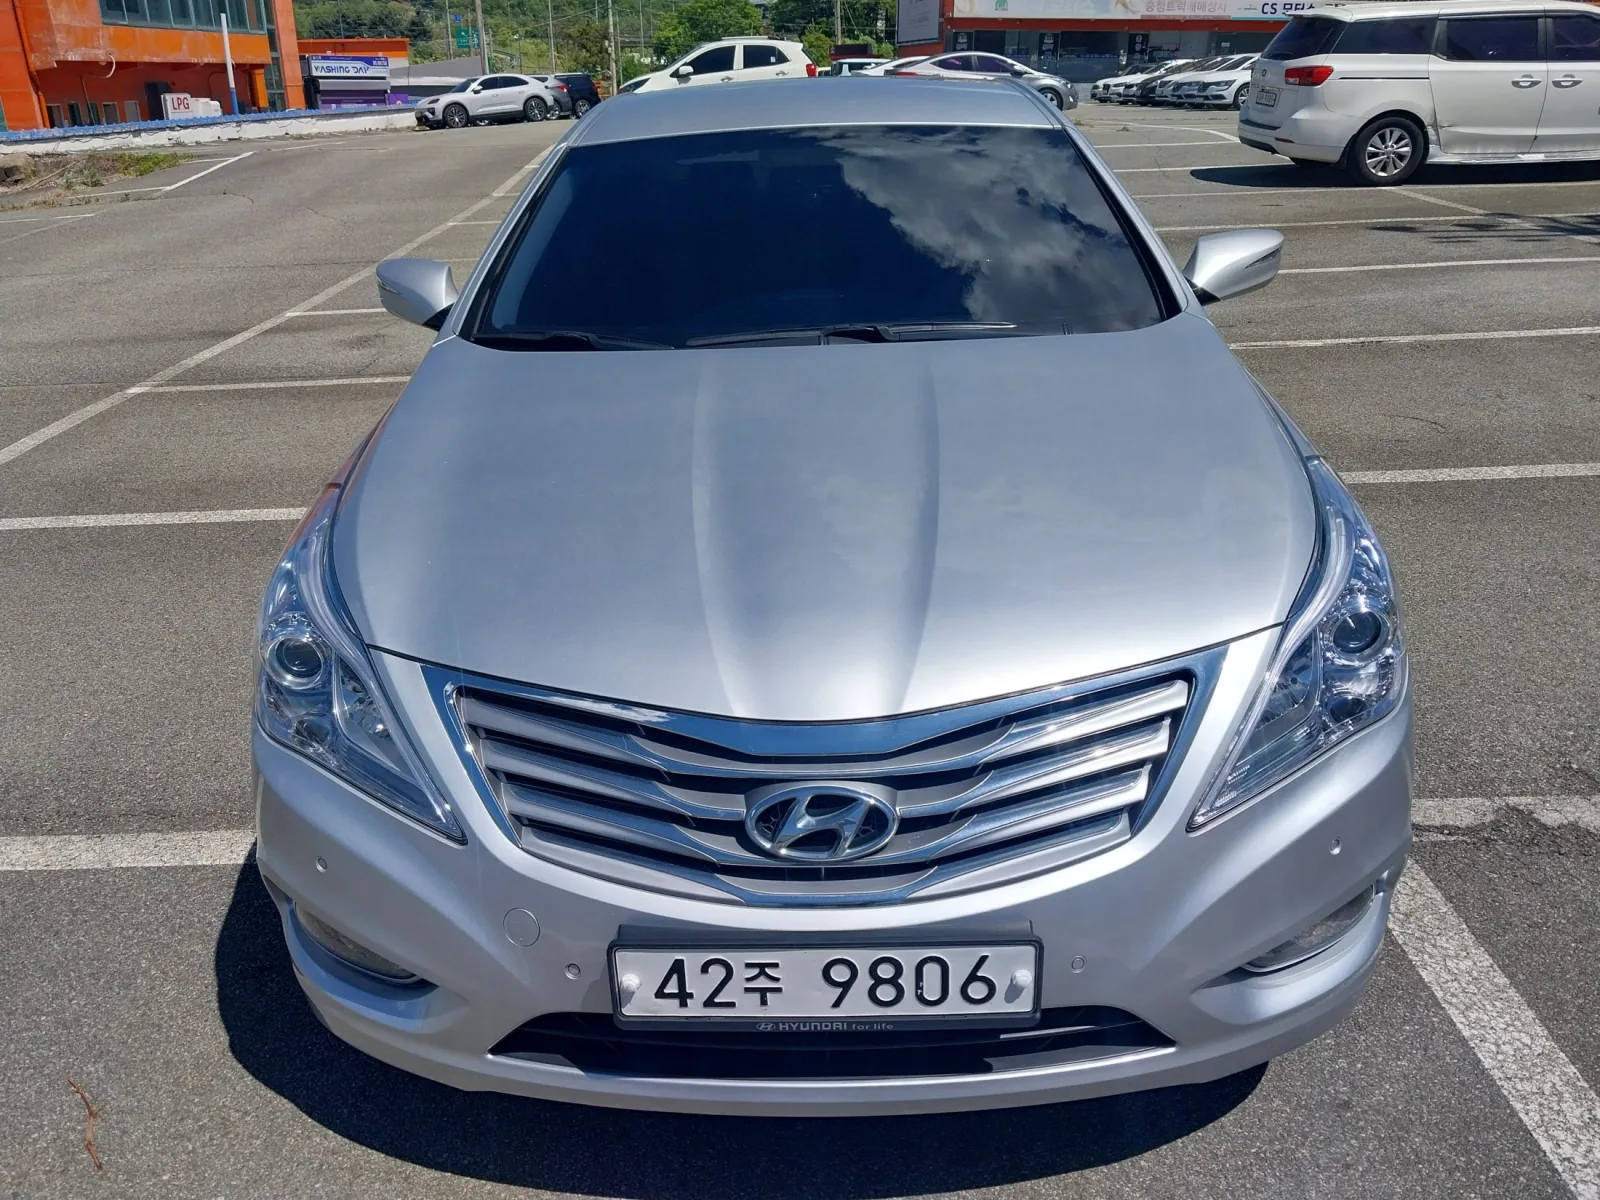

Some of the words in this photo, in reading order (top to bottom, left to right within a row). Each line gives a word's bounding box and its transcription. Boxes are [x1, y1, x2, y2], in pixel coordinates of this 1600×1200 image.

[1261, 2, 1278, 15] CS
[352, 66, 370, 74] DAY
[171, 97, 190, 110] LPG
[653, 956, 784, 1009] 42주
[820, 953, 998, 1009] 9806
[779, 1022, 848, 1031] HYUNDAI
[851, 1023, 871, 1031] for
[873, 1023, 894, 1031] life
